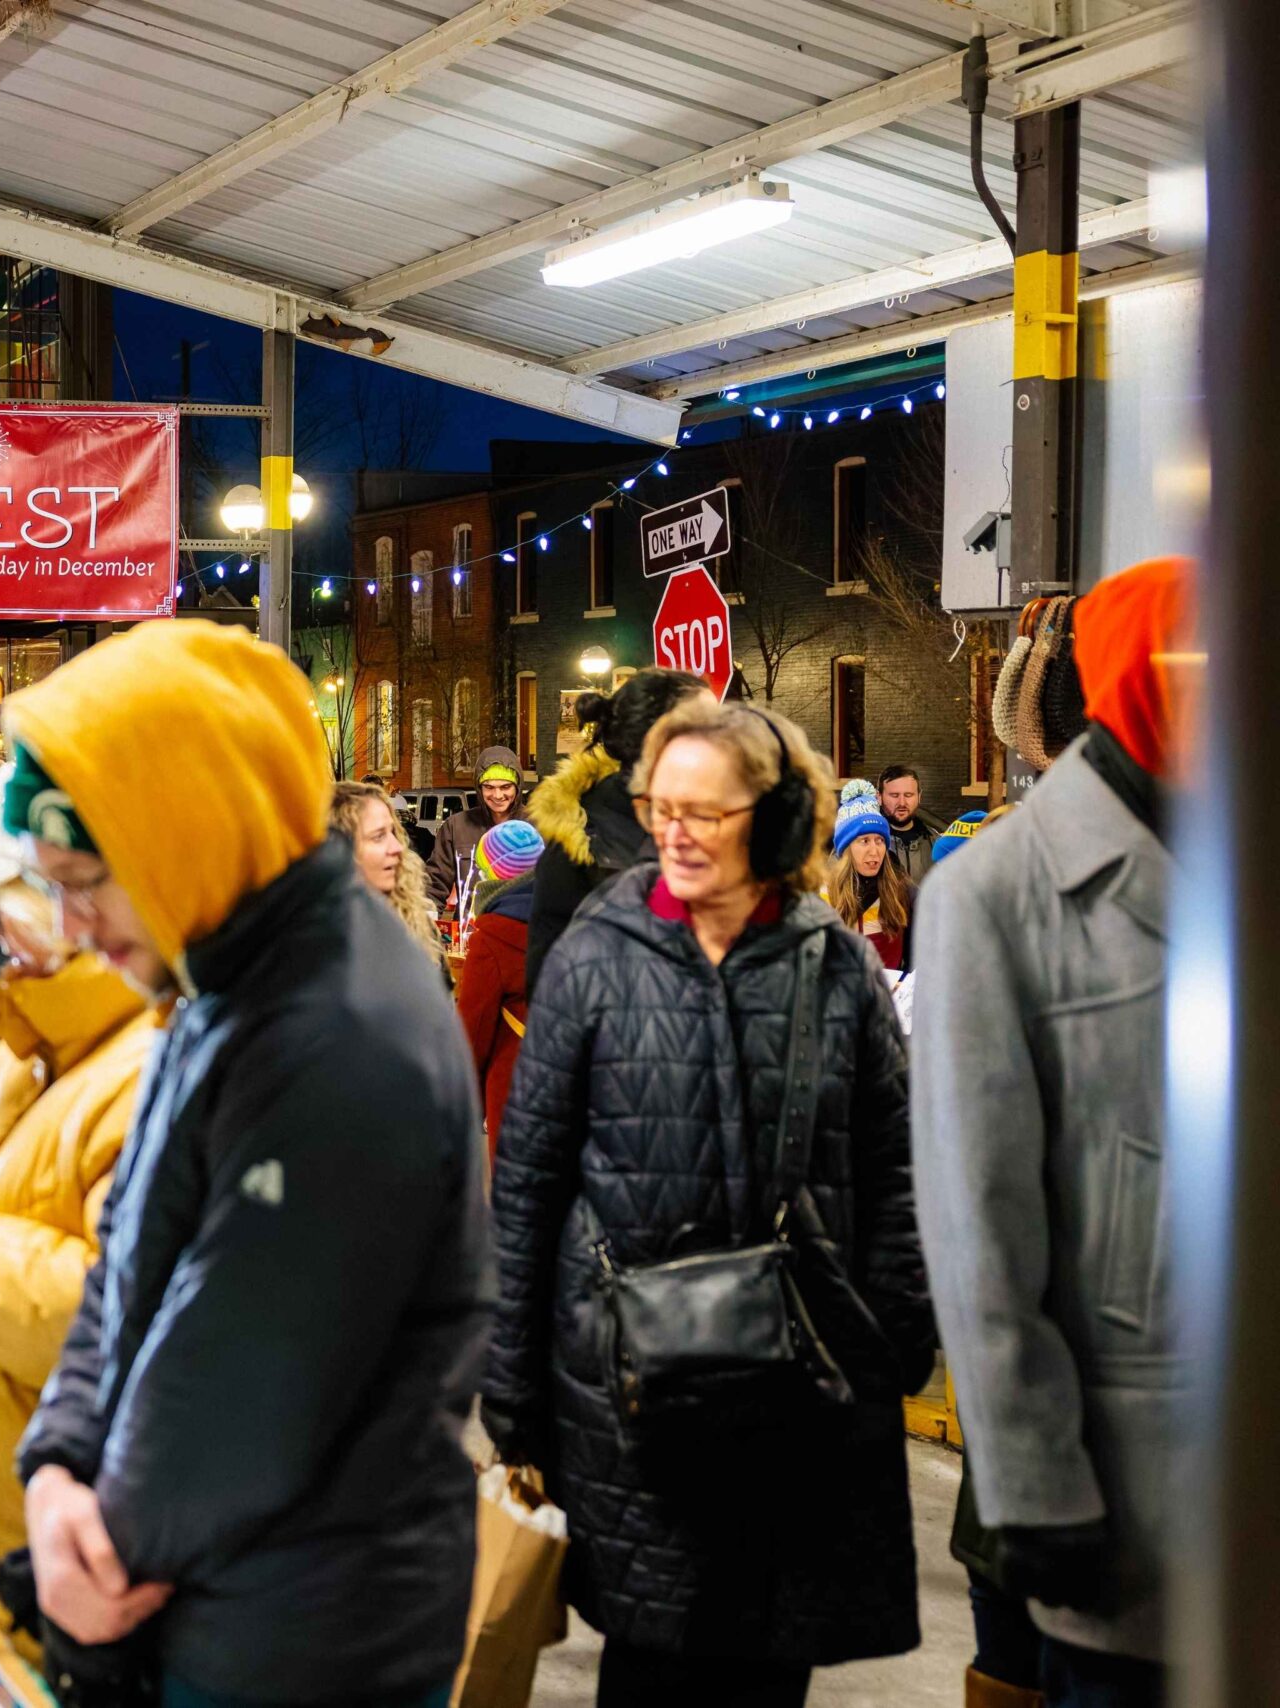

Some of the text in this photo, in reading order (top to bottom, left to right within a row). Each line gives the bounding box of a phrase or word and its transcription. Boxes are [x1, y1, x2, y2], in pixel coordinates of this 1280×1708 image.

[651, 516, 703, 554] ONE WAY
[35, 557, 52, 575] in
[58, 556, 155, 576] December
[660, 615, 723, 677] STOP
[1012, 775, 1034, 788] 143
